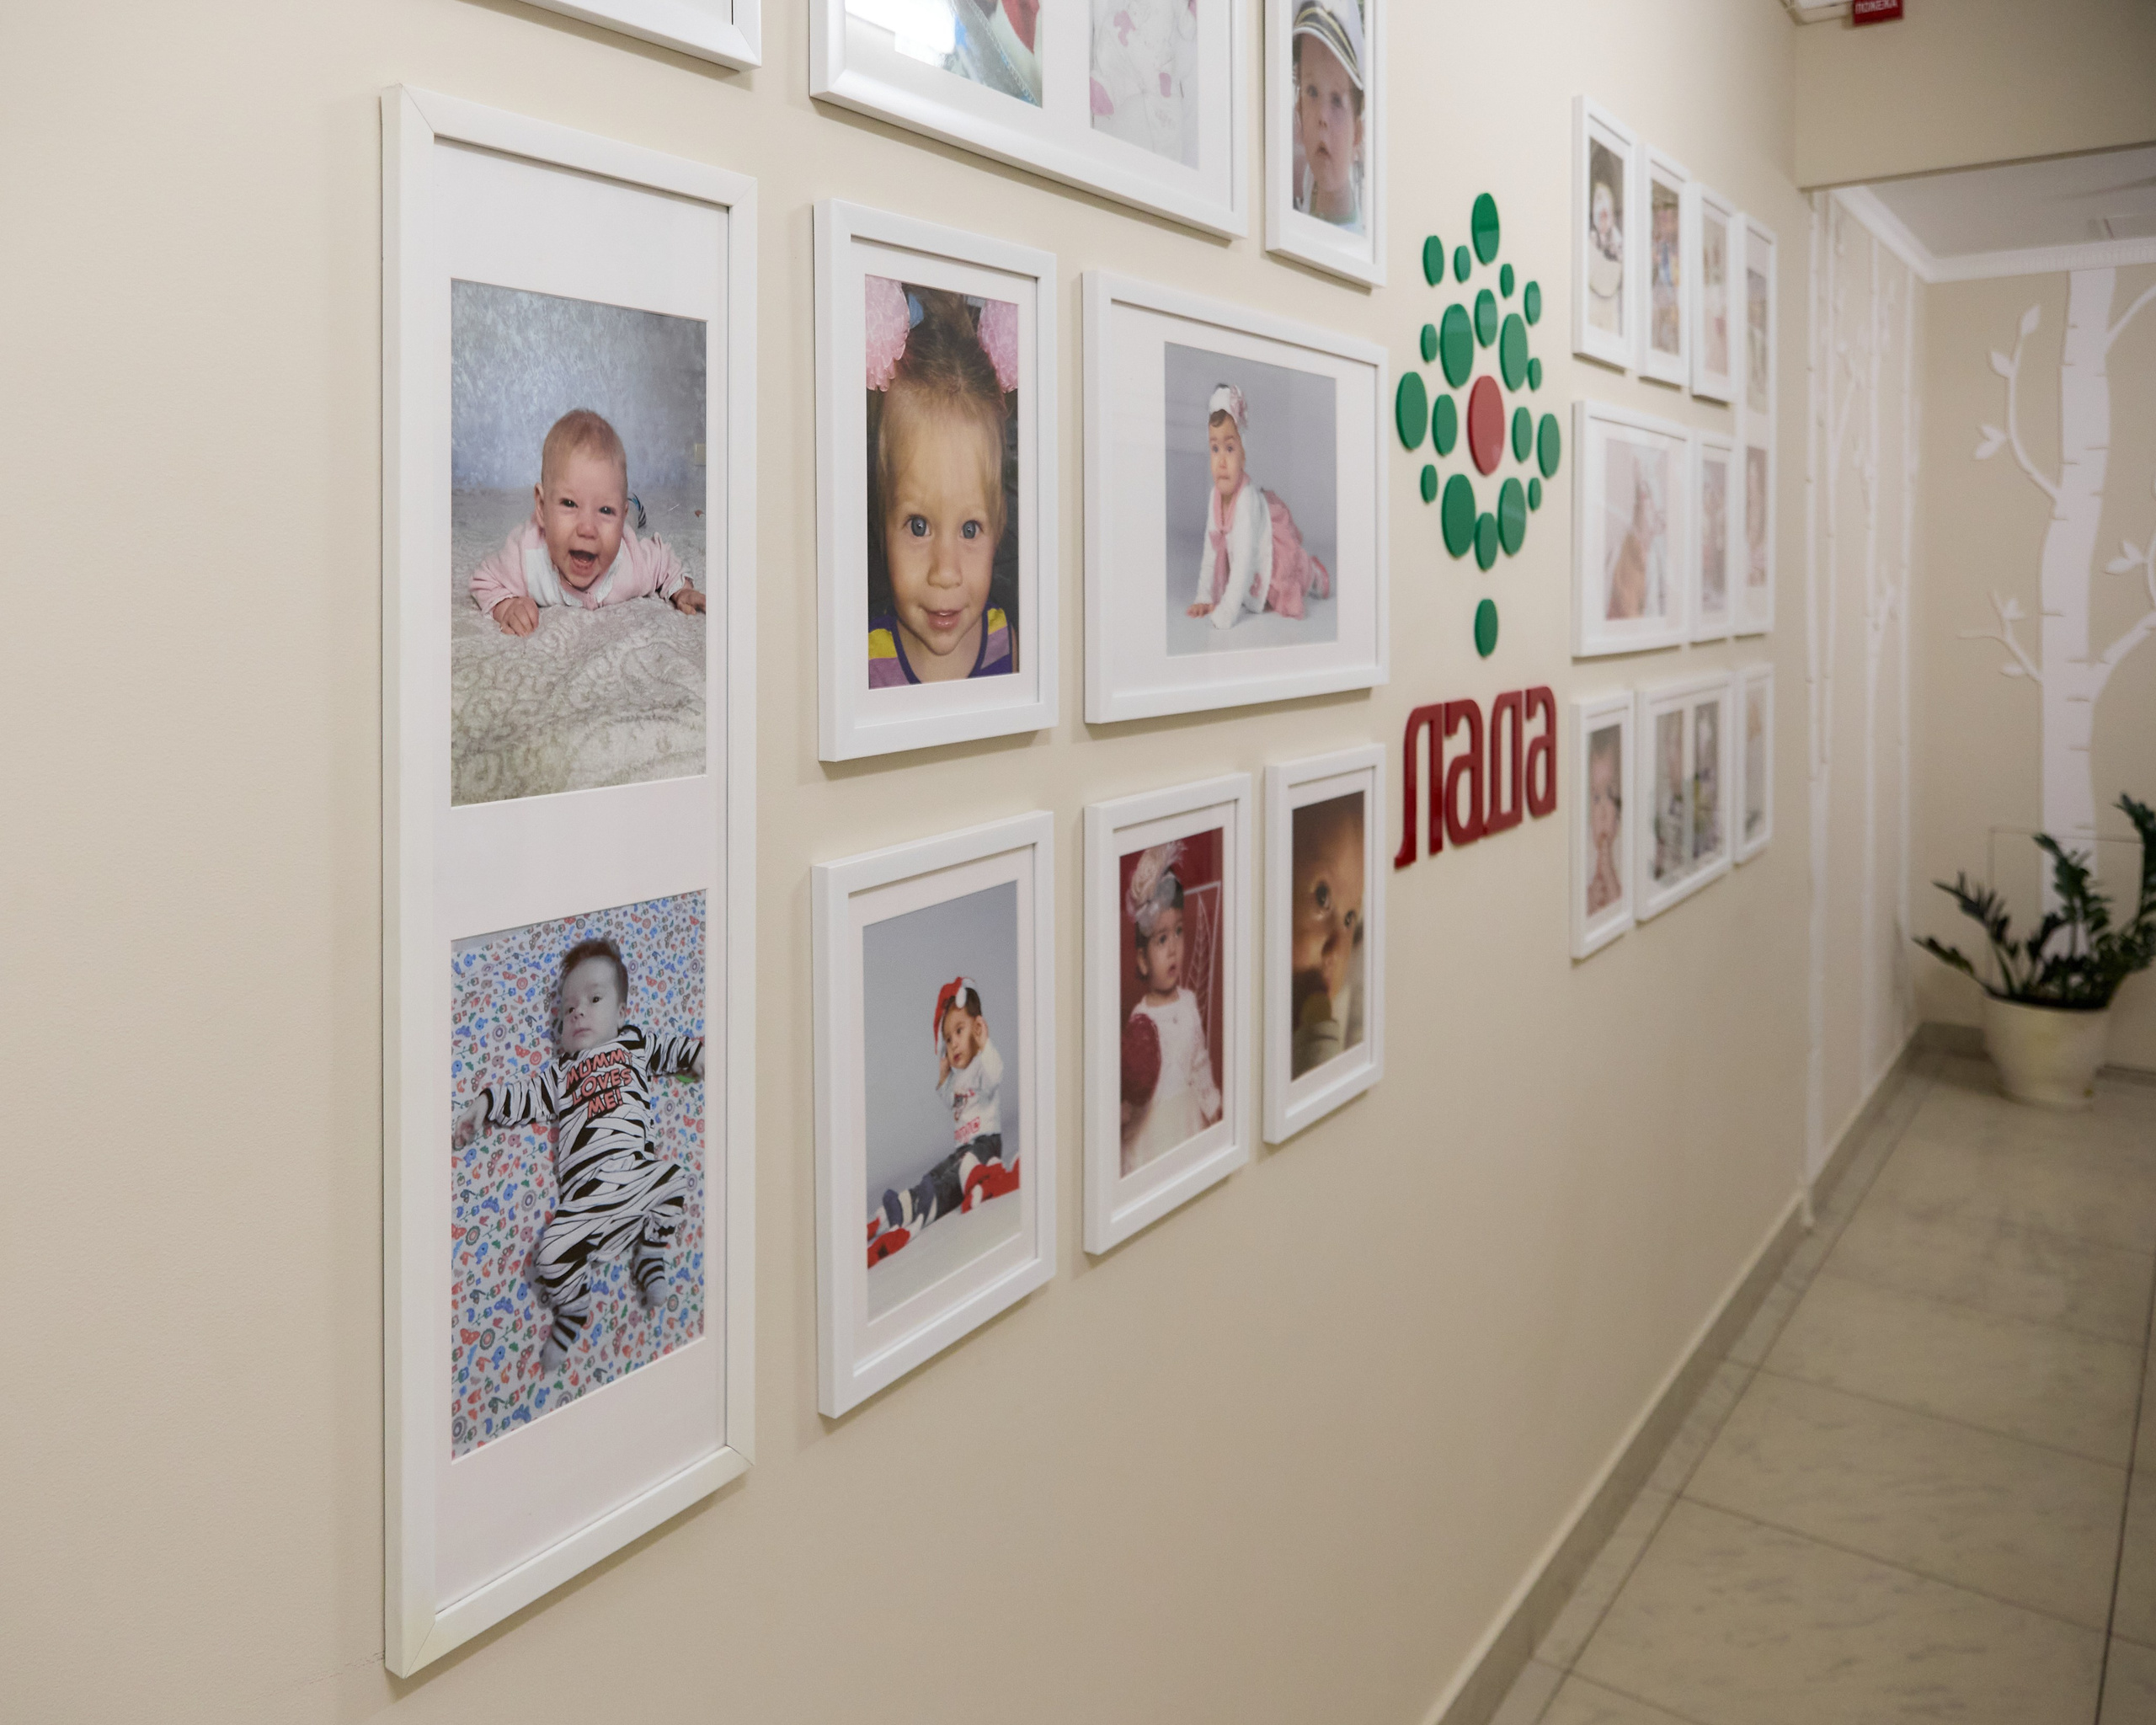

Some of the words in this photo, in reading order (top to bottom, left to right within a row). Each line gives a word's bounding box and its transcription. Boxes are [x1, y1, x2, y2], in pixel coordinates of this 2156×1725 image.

[566, 1049, 632, 1090] MUMMY
[572, 1069, 632, 1105] LOVES
[588, 1089, 624, 1118] ME!
